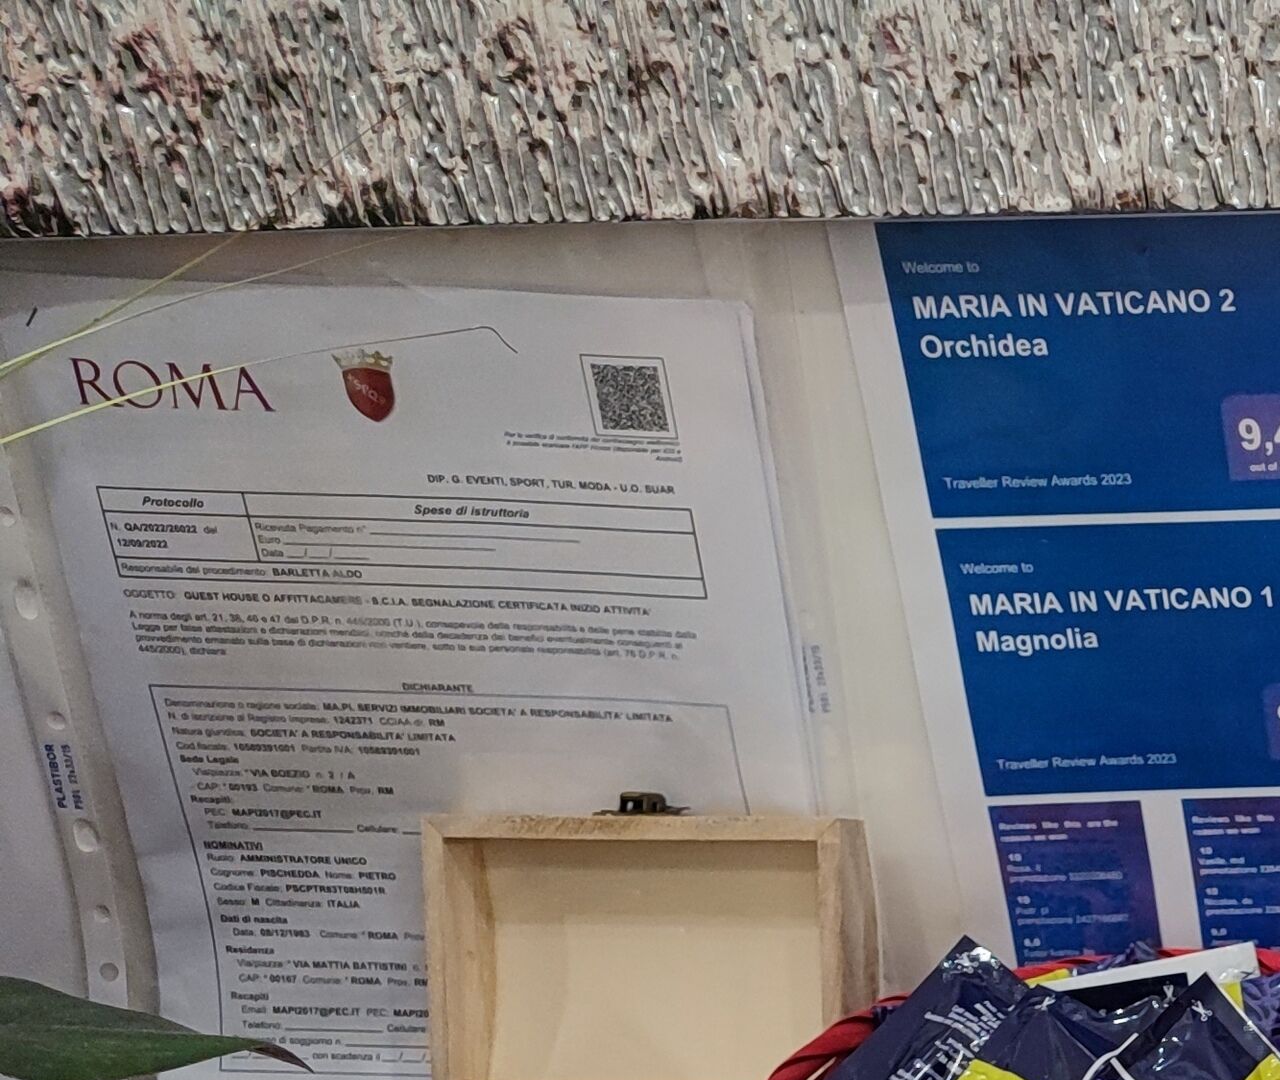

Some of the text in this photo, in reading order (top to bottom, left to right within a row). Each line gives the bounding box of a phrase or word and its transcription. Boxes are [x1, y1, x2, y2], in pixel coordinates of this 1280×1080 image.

[903, 260, 980, 275] Welcome to
[912, 288, 1237, 320] MARIA IN VATICANO 2
[919, 334, 1049, 359] Orchidea
[70, 357, 277, 414] ROMA
[943, 473, 1133, 490] Traveller Review Awards 2023
[142, 495, 205, 510] Protocollo
[413, 504, 531, 520] Spese di istruttoria
[960, 561, 1034, 575] Welcome to
[183, 591, 220, 602] GUEST
[222, 592, 259, 603] HOUSE
[969, 586, 1275, 616] MARIA IN VATICANO 1
[975, 628, 1100, 657] Magnolia
[997, 753, 1177, 771] Traveller Review Awards 2023
